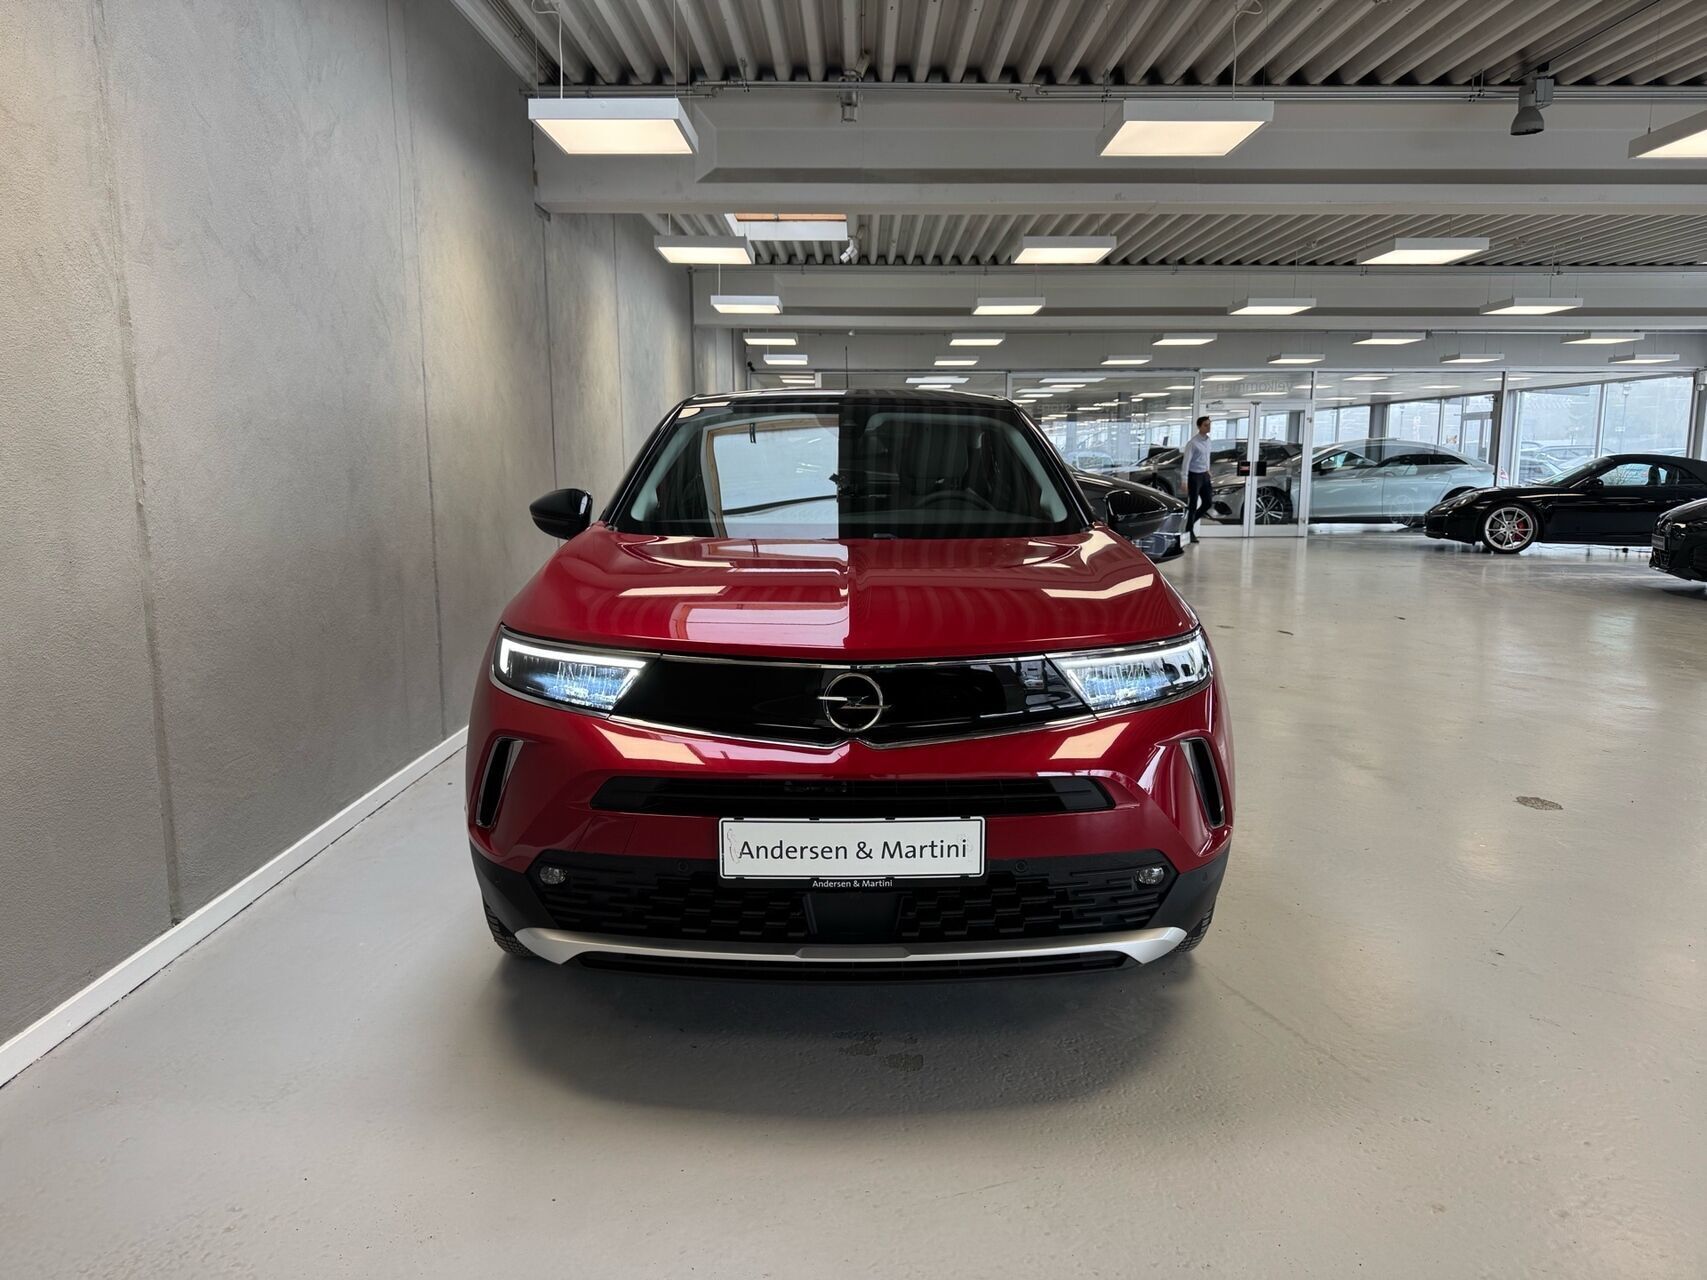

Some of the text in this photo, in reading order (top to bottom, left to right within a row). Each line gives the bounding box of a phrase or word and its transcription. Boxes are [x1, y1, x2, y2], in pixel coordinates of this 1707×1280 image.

[738, 839, 967, 860] Andersen & Martini
[812, 879, 893, 888] Andersen & Martini
